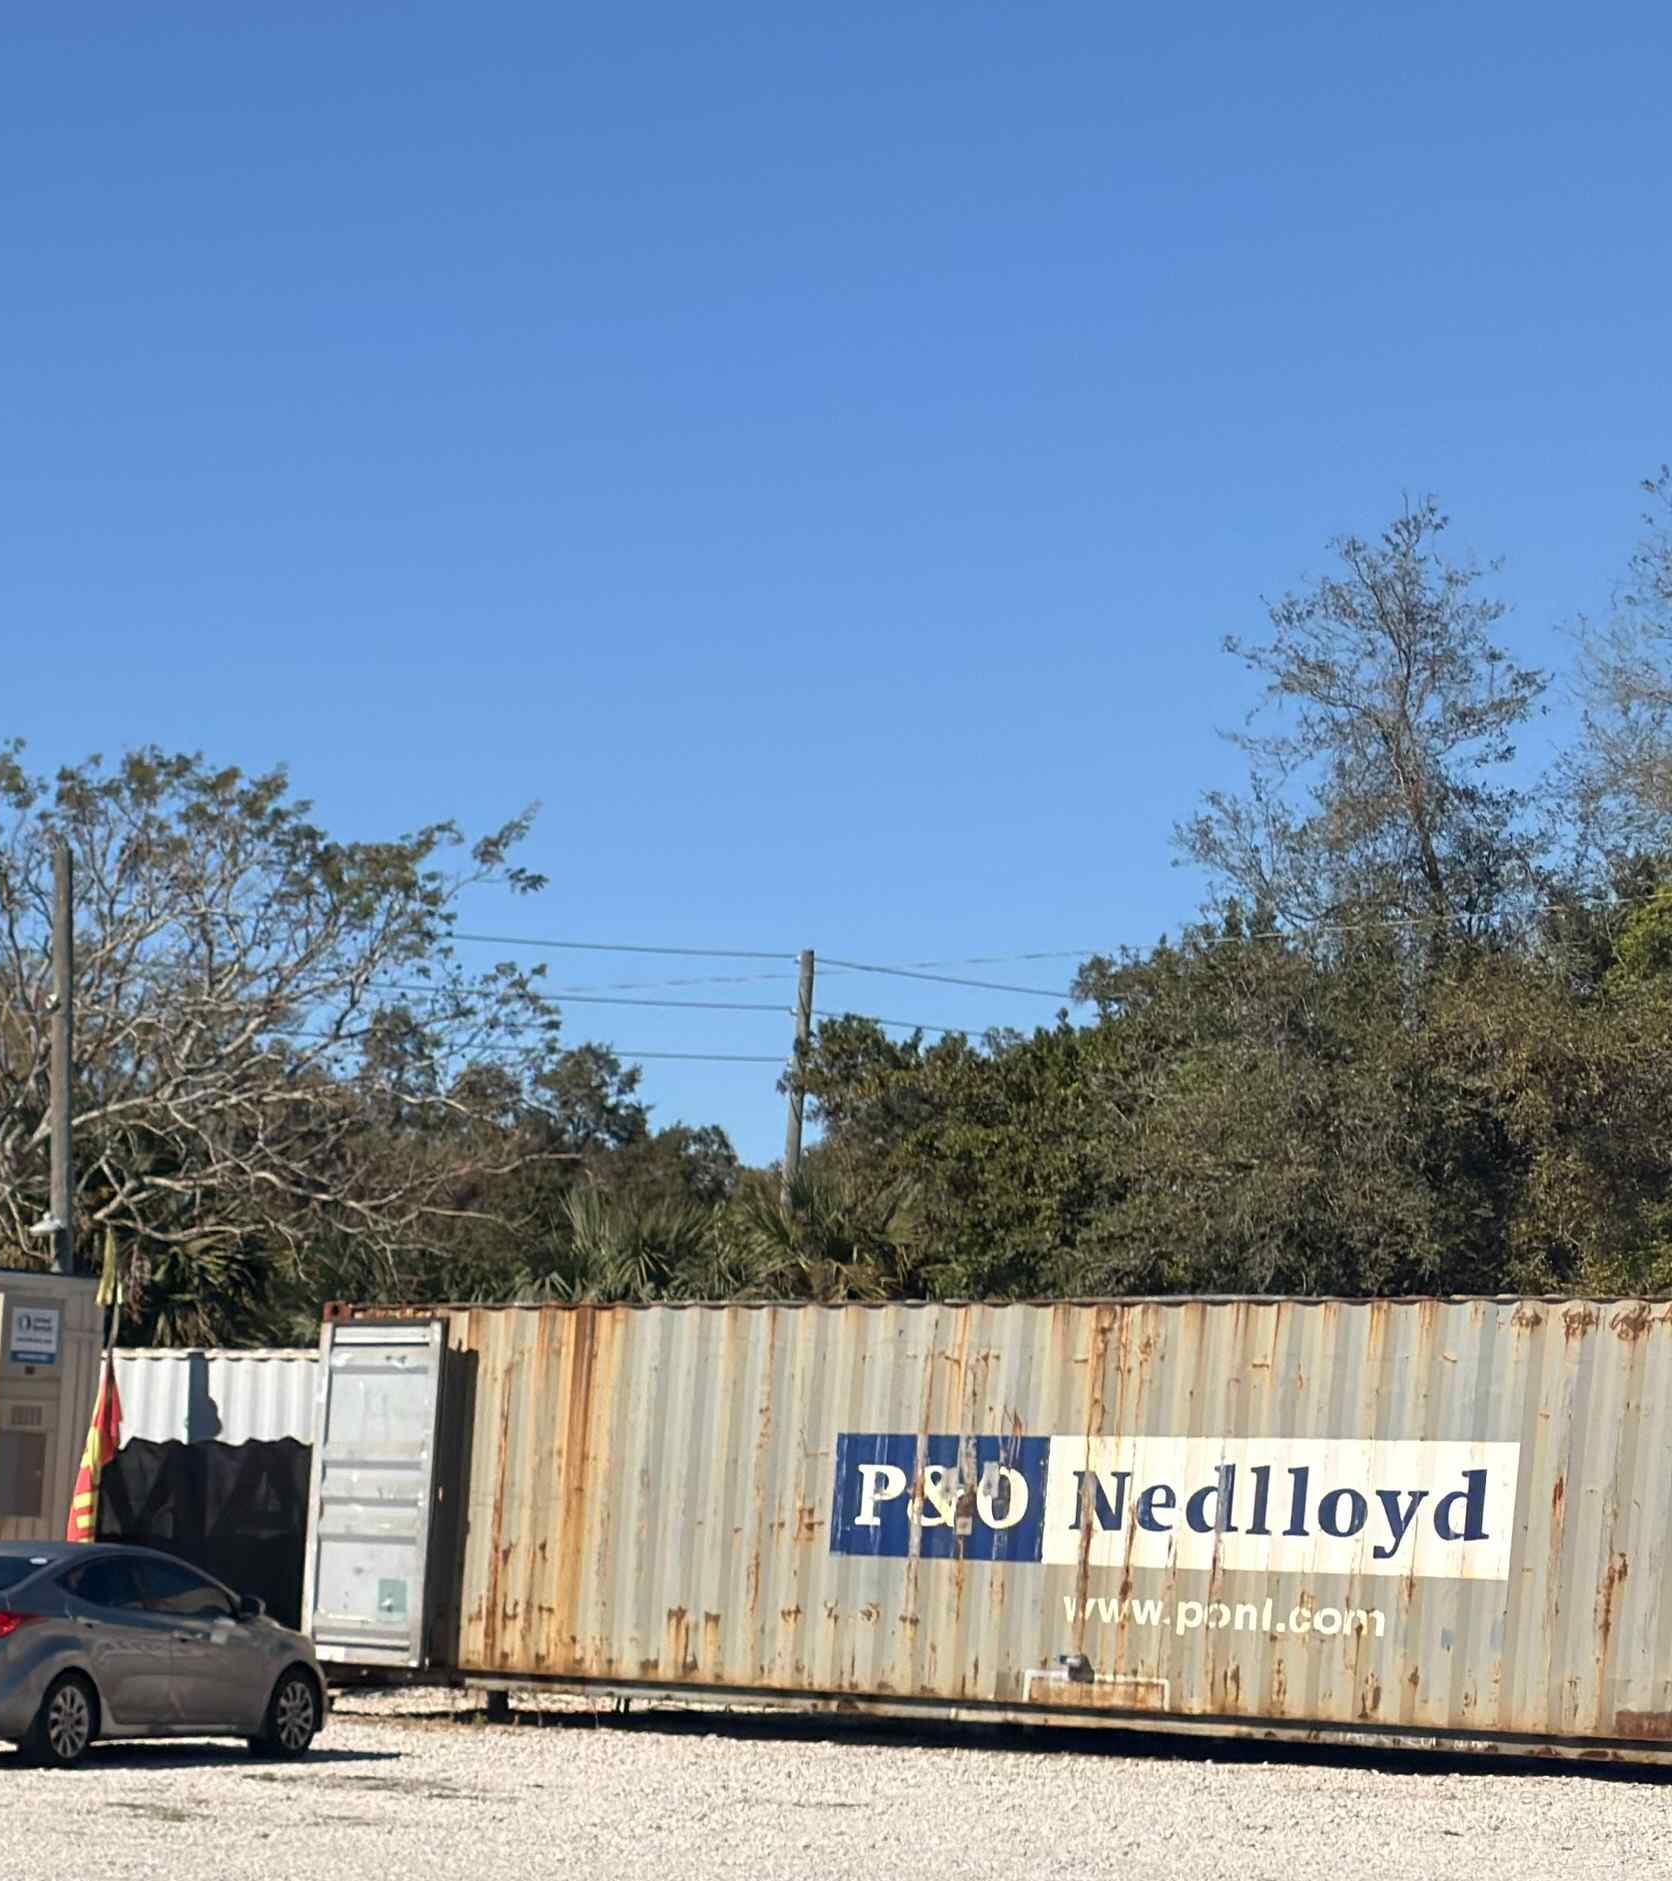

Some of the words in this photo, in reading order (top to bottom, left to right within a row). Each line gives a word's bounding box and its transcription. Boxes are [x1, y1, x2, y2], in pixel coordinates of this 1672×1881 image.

[853, 1462, 1029, 1531] P&O
[1069, 1464, 1490, 1559] Nedlloyd
[1063, 1596, 1385, 1637] www.ponl.com
